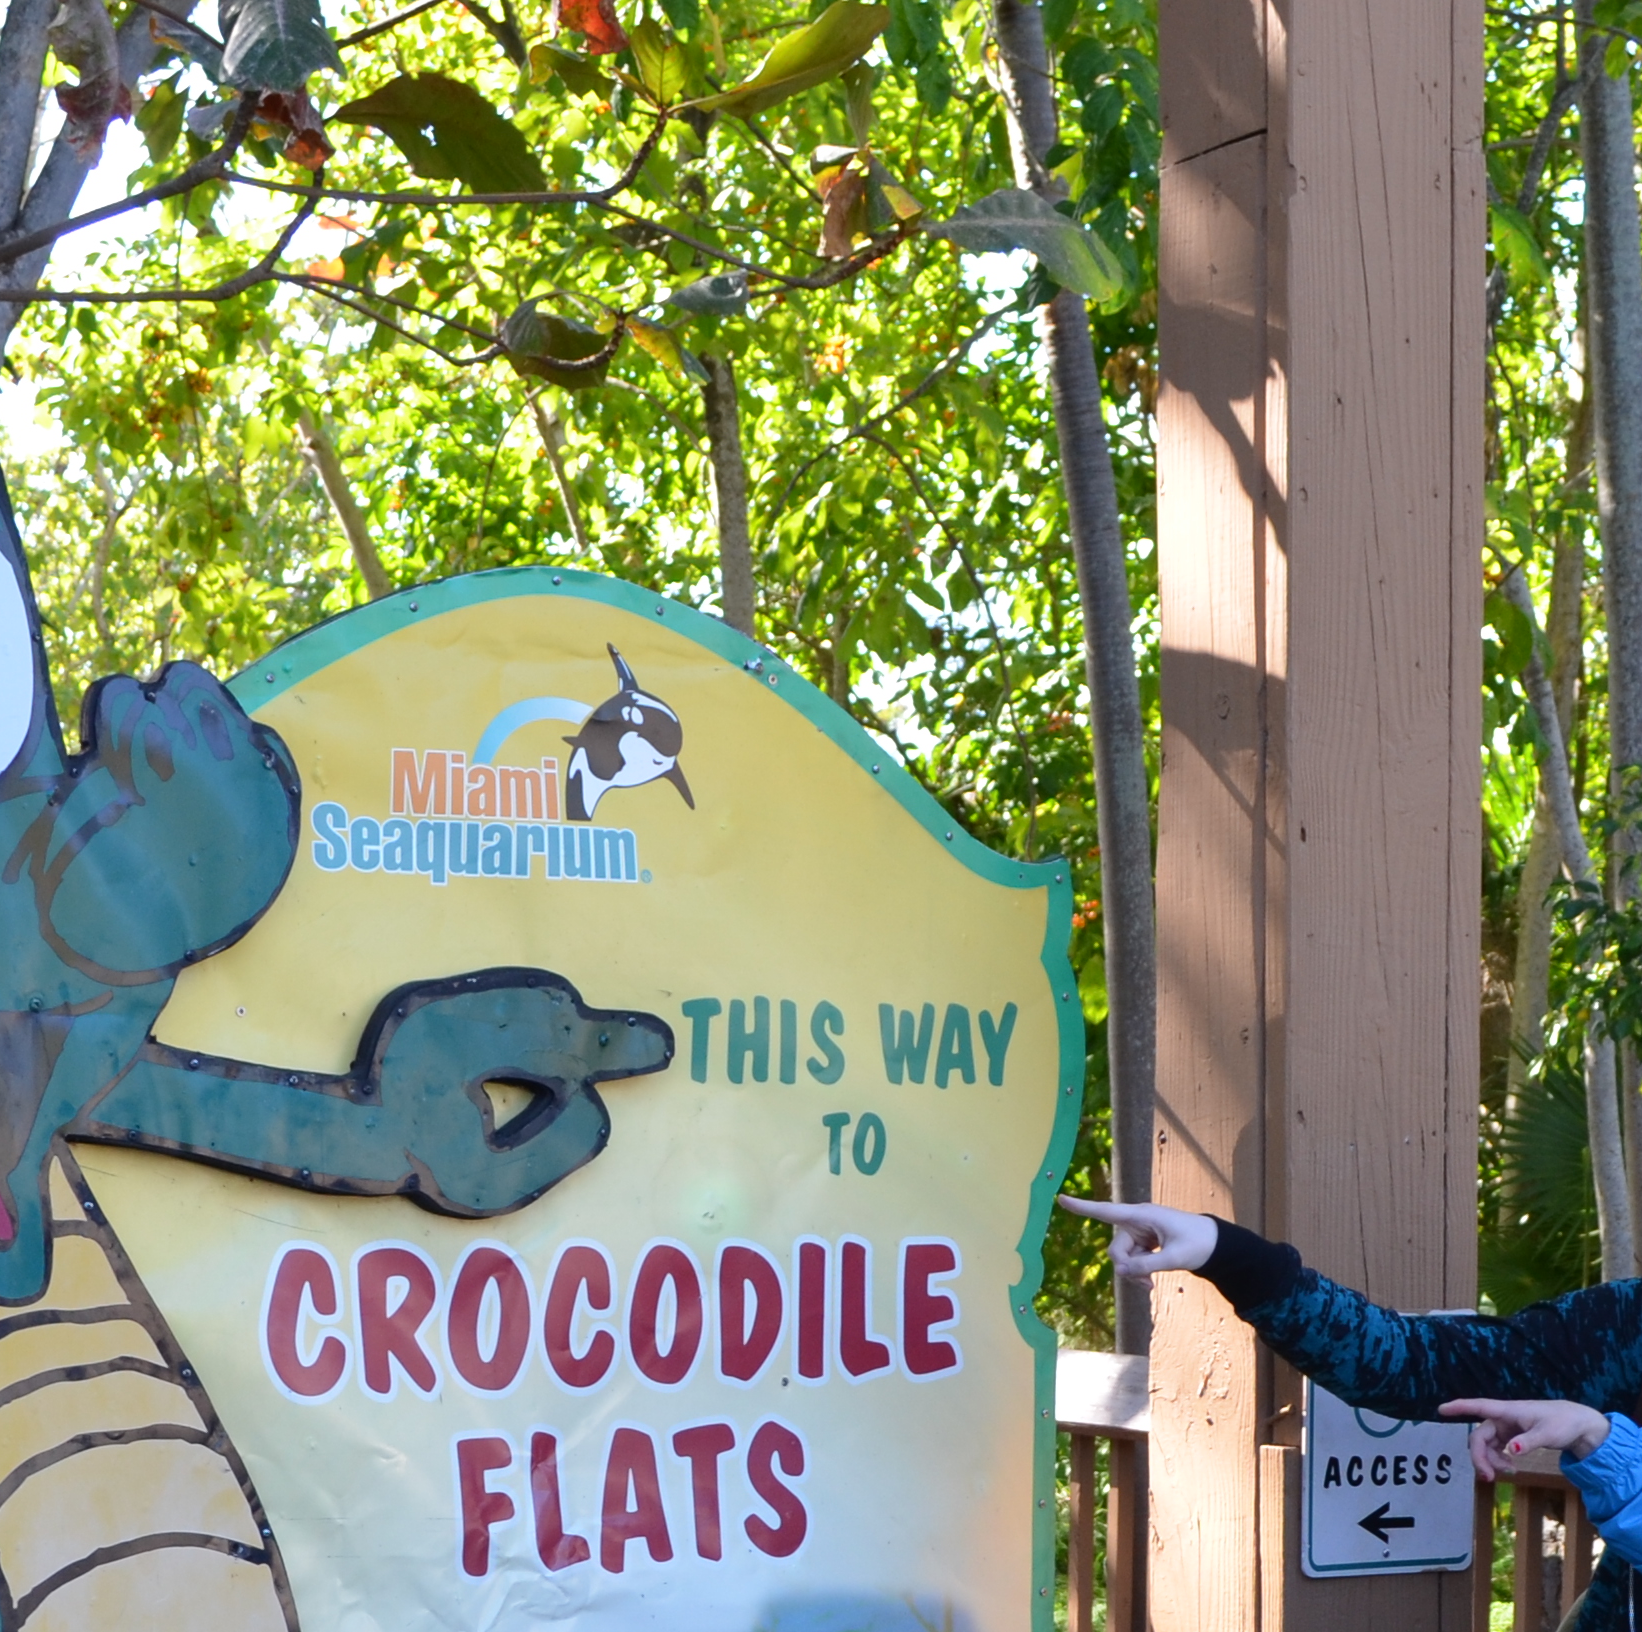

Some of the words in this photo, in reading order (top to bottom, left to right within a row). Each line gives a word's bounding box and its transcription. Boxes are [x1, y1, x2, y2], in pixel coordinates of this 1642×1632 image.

[390, 748, 560, 822] Miami
[310, 801, 638, 886] Seaquarium
[681, 995, 845, 1085] THIS
[878, 1001, 1018, 1089] WAY
[822, 1112, 887, 1176] TO
[266, 1241, 958, 1397] CROCODILE
[456, 1420, 808, 1577] FLATS
[1323, 1454, 1452, 1489] ACCESS
